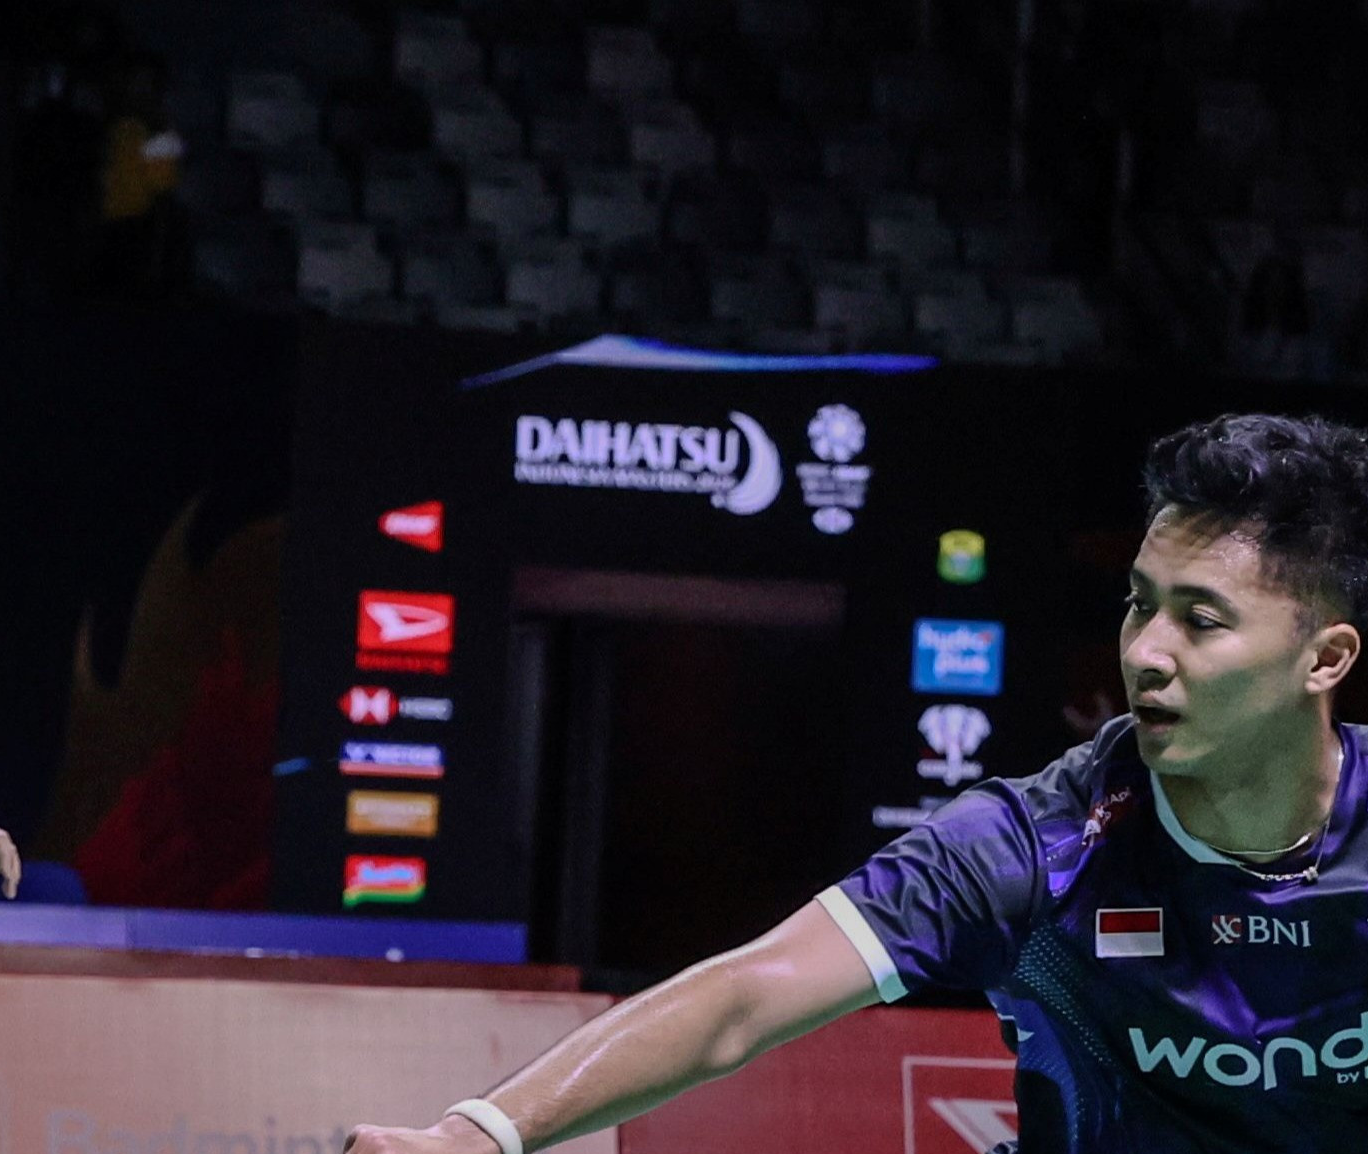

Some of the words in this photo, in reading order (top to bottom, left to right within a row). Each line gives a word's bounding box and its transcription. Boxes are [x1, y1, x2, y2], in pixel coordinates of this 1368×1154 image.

[515, 414, 740, 475] DAIHATSU
[1247, 914, 1313, 948] BNI
[1336, 1071, 1360, 1085] by
